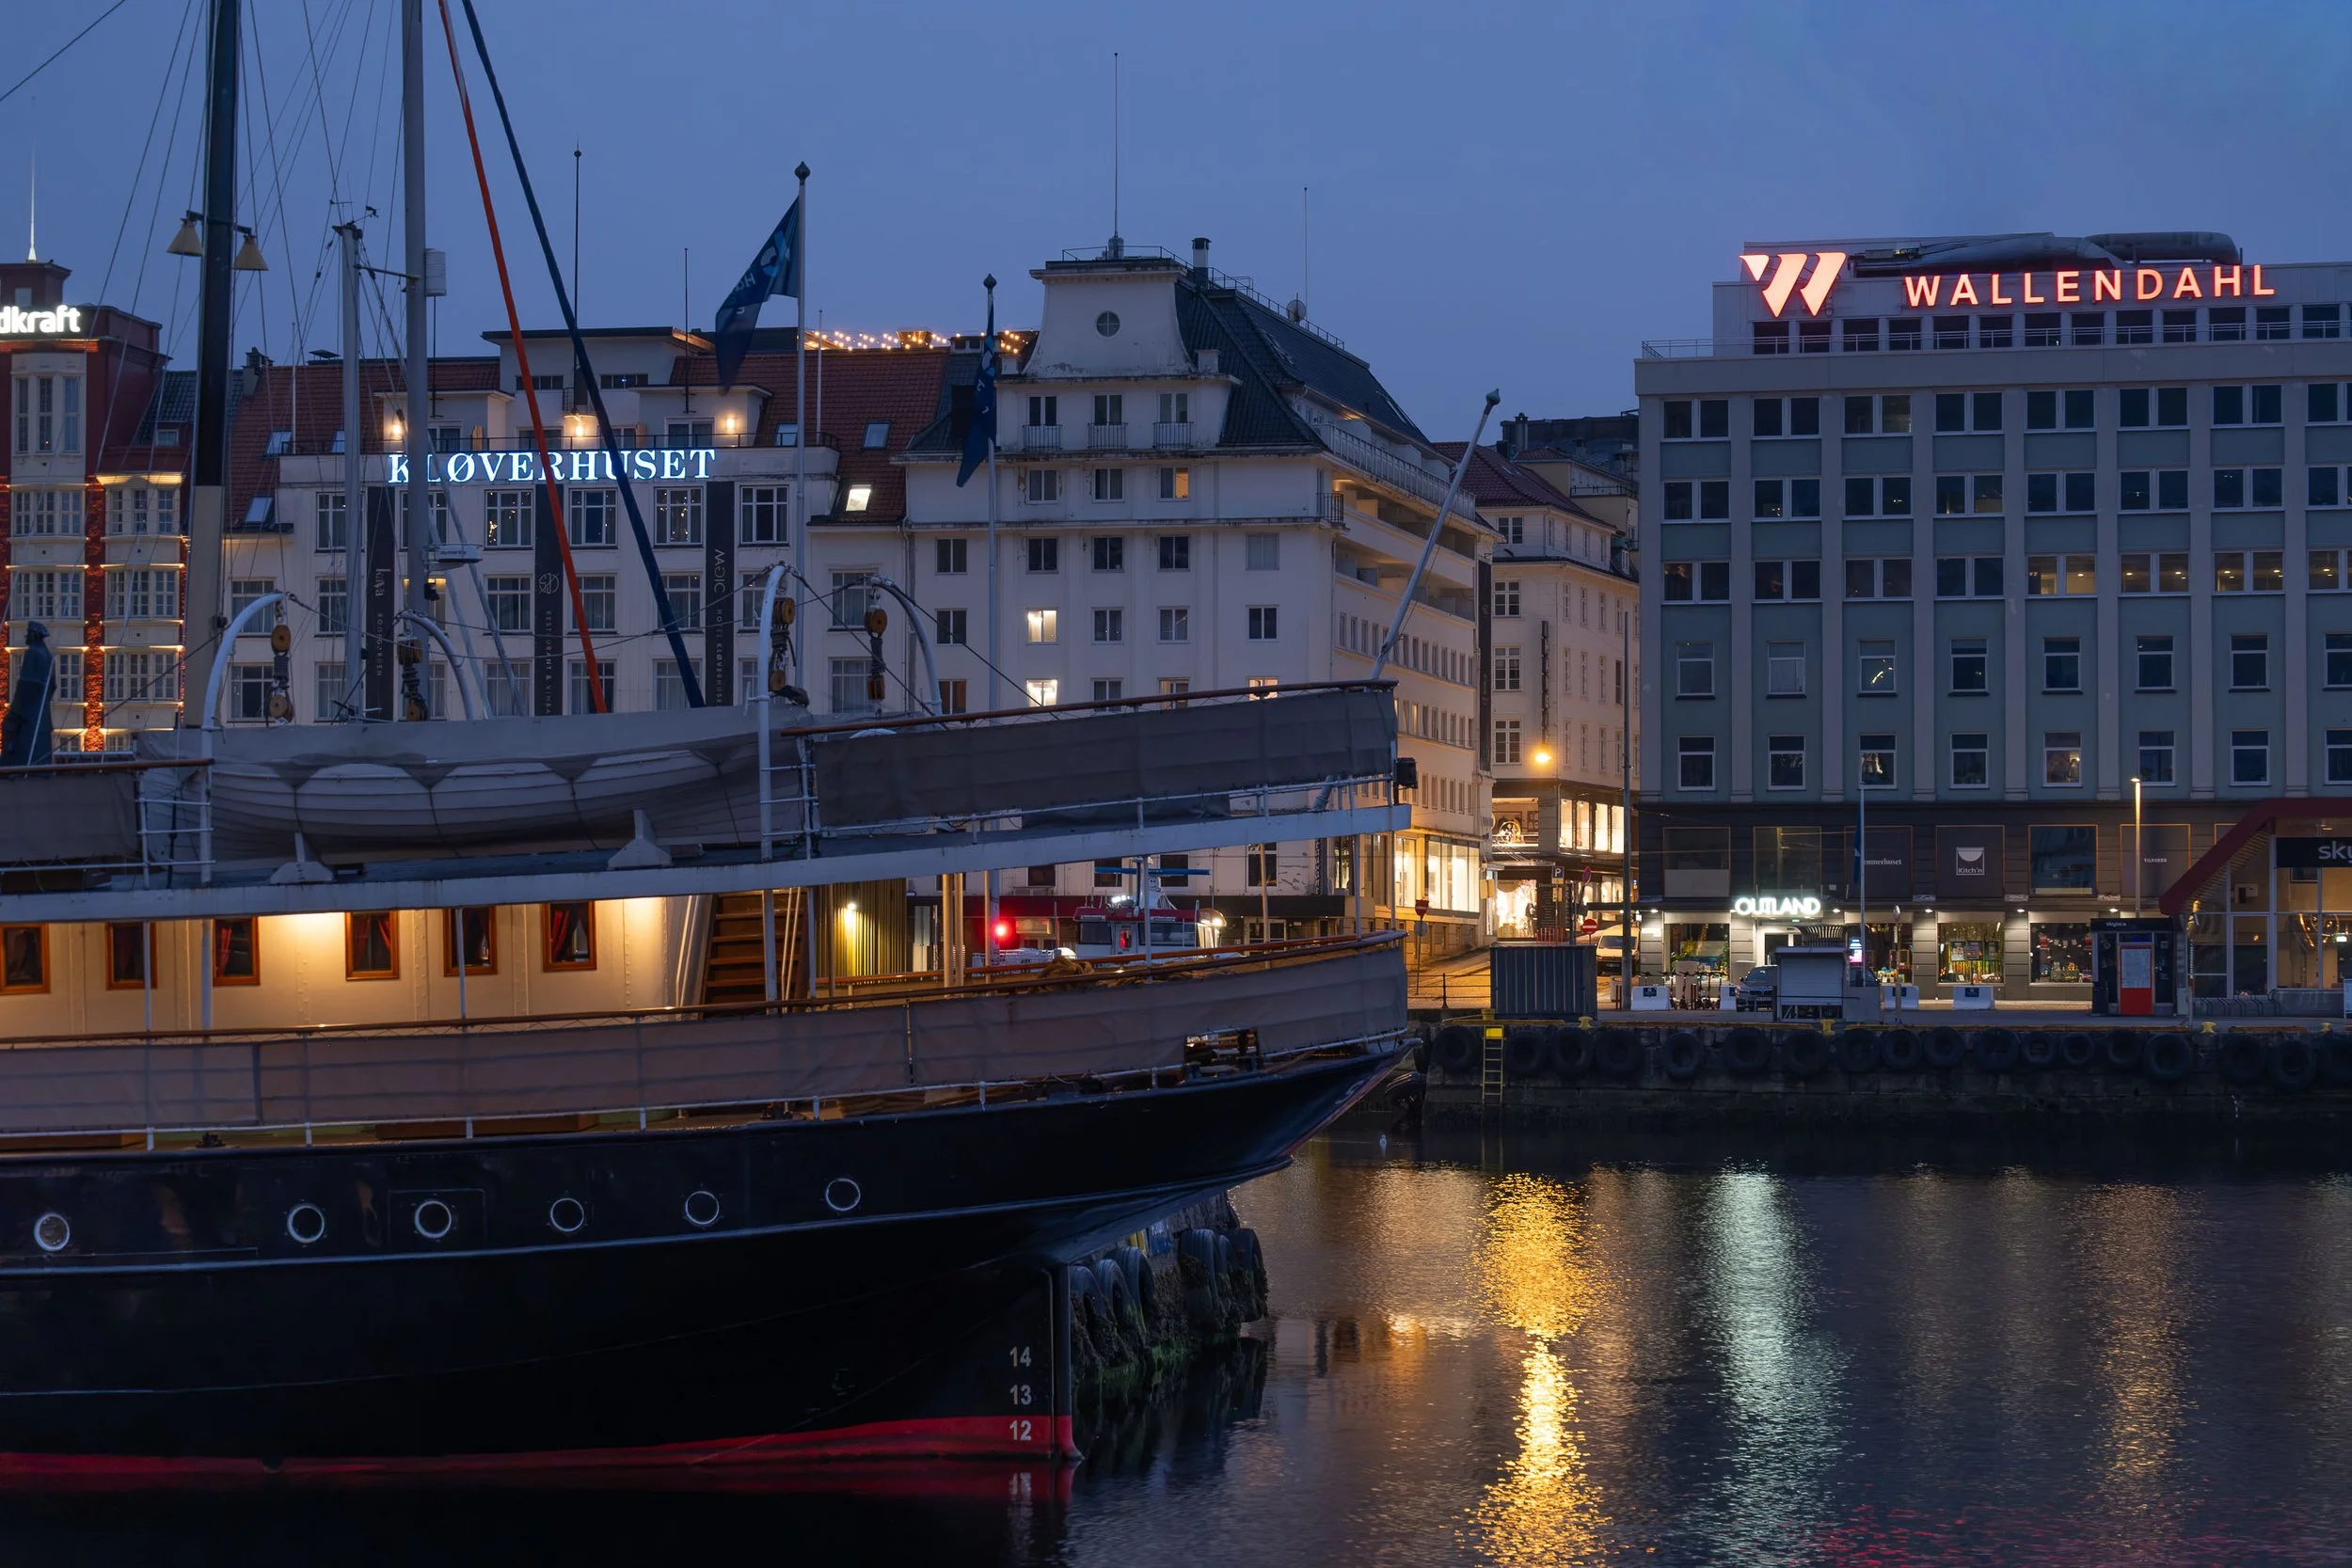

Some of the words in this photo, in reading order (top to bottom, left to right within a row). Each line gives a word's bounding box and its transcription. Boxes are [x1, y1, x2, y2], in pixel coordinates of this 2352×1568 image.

[1904, 263, 2276, 308] WALLENDAHL
[388, 449, 716, 484] KLØVERHUSET
[1554, 867, 1562, 878] P
[1734, 896, 1821, 916] OUTLAND
[1009, 1346, 1032, 1368] 14
[1009, 1384, 1032, 1405] 13
[1009, 1419, 1032, 1441] 12
